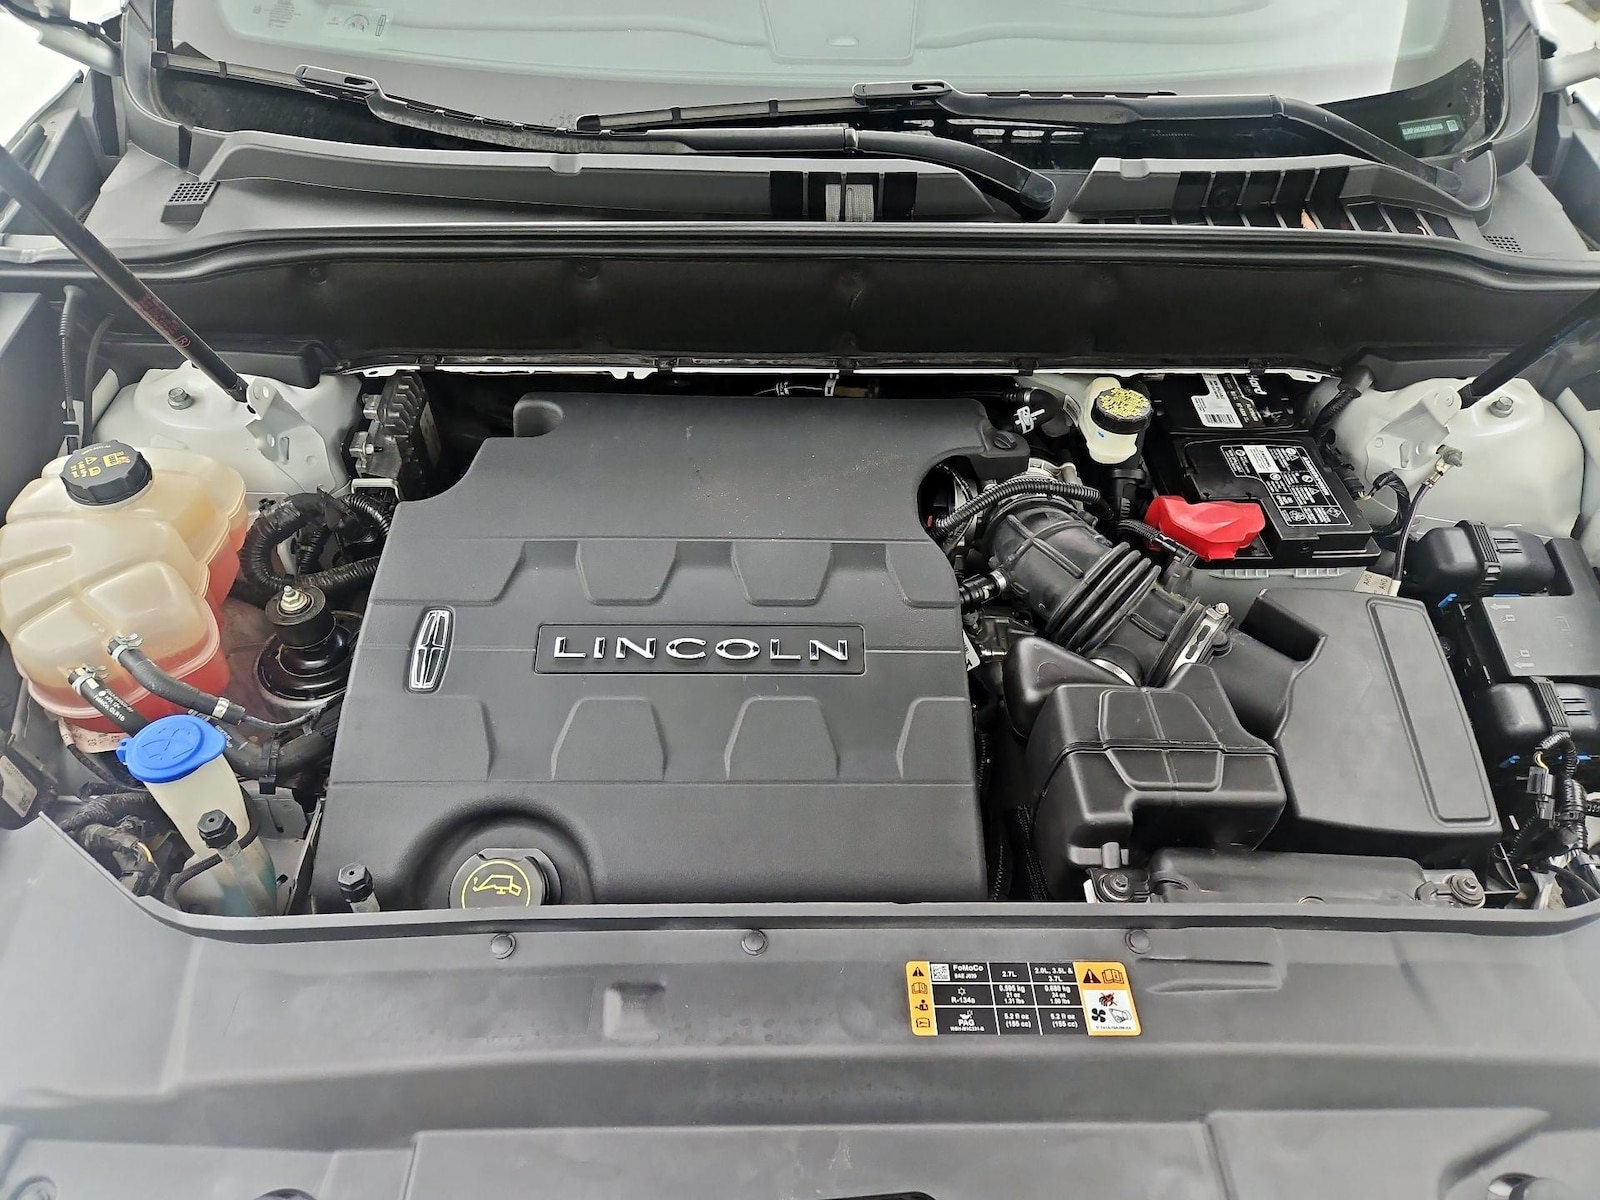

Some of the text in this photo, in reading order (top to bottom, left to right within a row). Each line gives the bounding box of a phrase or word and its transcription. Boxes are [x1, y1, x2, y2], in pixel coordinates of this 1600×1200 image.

[554, 636, 848, 661] LINCOLN
[953, 964, 984, 972] FoMoCo
[1016, 985, 1026, 993] kg
[1062, 985, 1071, 993] kg
[951, 996, 976, 1004] R-134a
[1005, 1020, 1032, 1028] (155 cc)
[1052, 1020, 1078, 1028] (155 cc)
